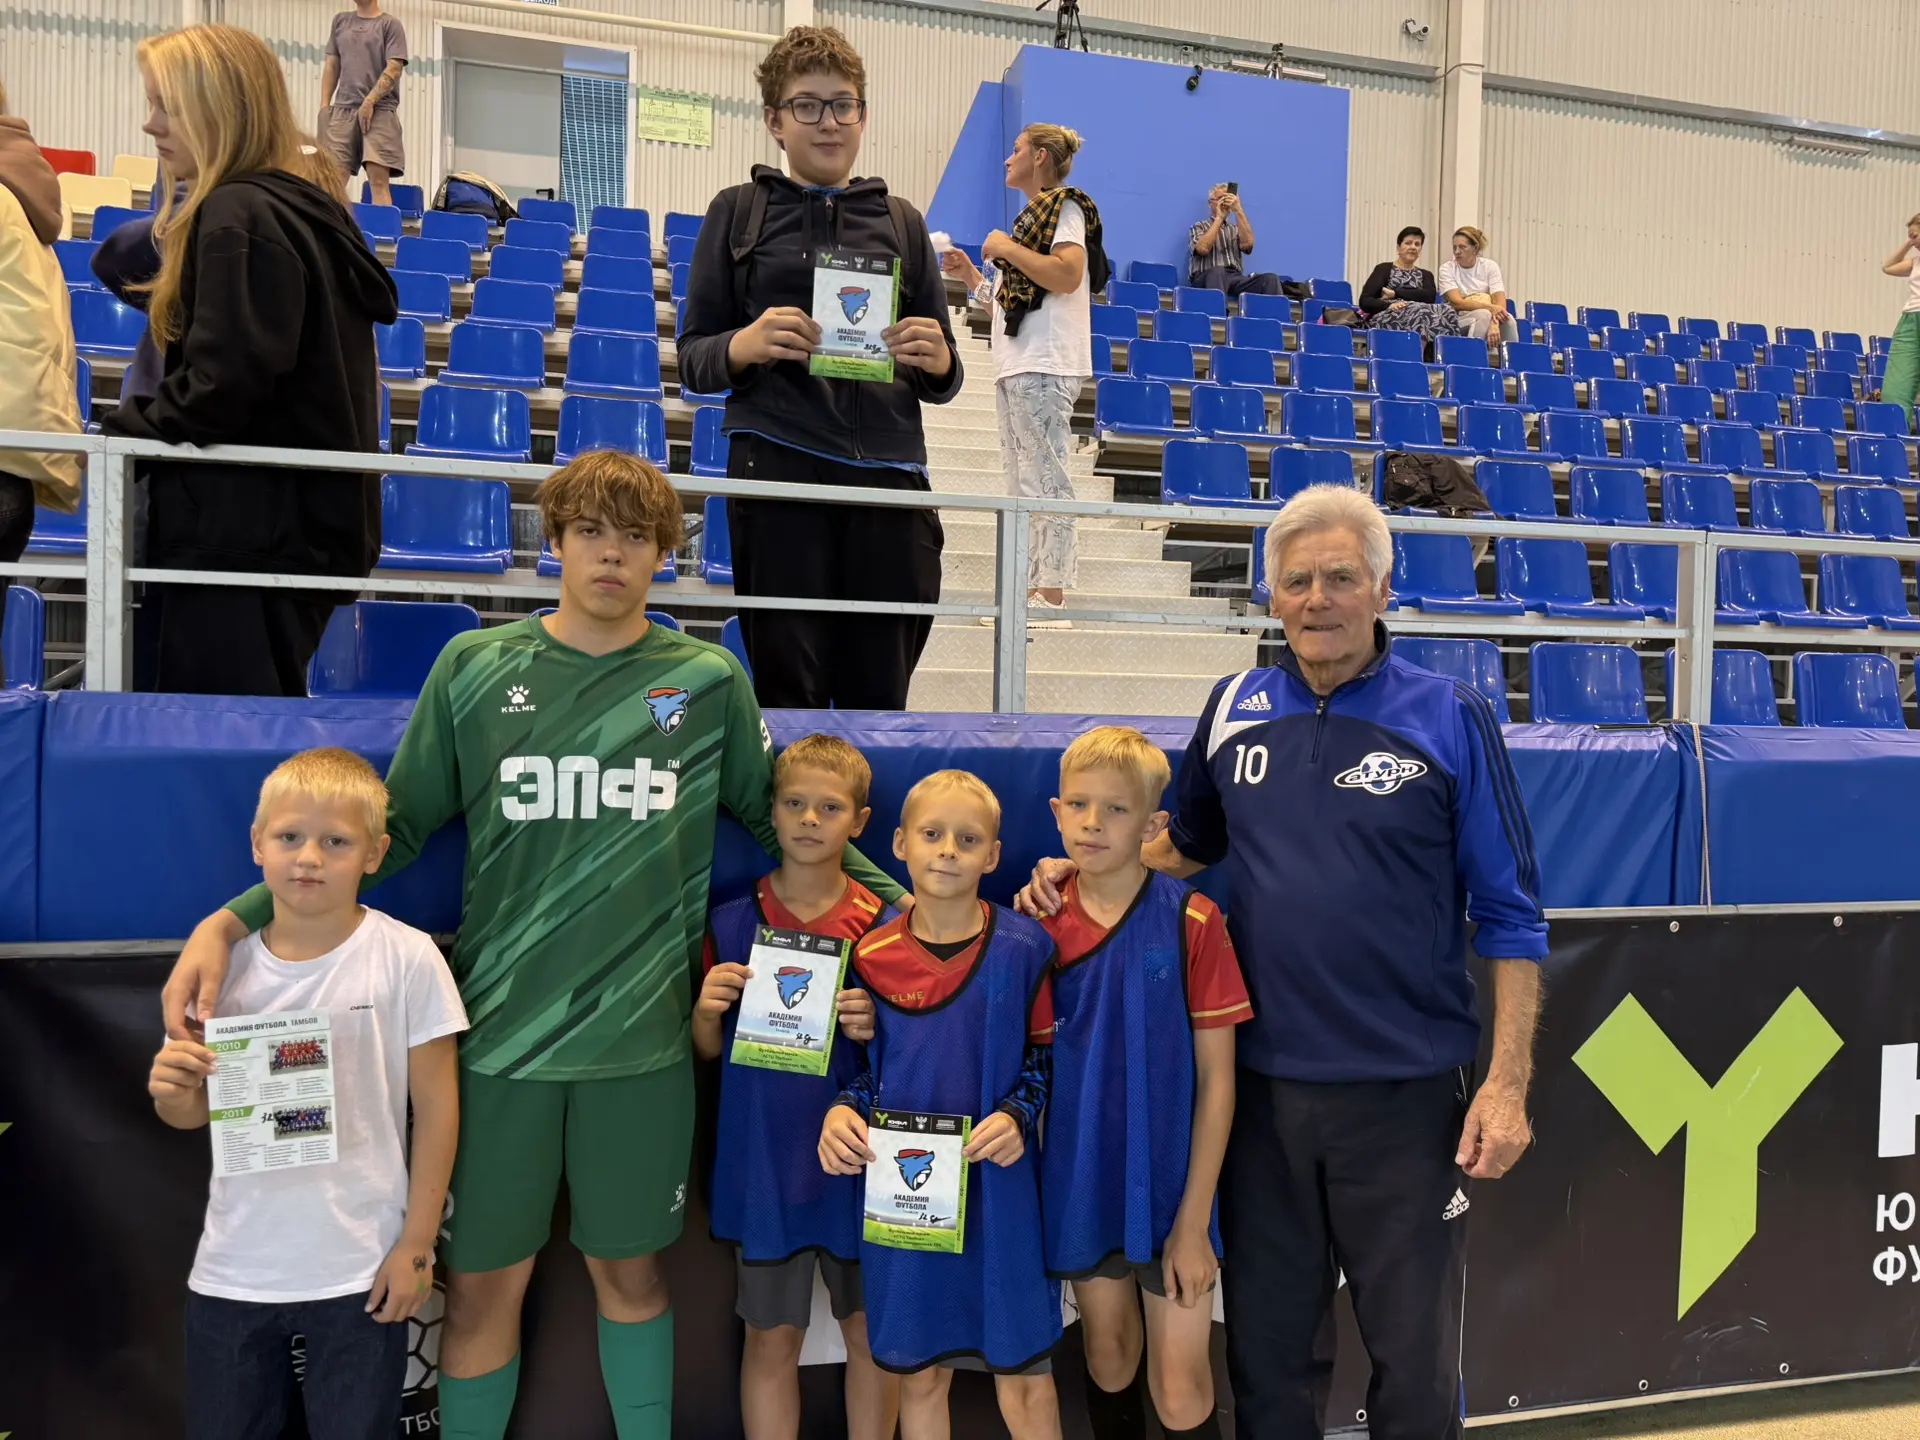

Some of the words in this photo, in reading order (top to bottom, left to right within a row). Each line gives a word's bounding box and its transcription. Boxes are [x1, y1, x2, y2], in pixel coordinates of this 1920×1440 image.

[501, 704, 536, 714] KELME
[1237, 702, 1272, 711] adidas
[1233, 745, 1268, 785] 10
[884, 991, 924, 1003] ELME
[768, 1012, 802, 1022] АКАДЕМИЯ
[216, 1023, 254, 1034] АКАДЕМИЯ
[254, 1020, 287, 1031] ФУТБОЛА
[291, 1017, 318, 1027] ТАМБОВ
[769, 1020, 799, 1030] ФУТБОЛА
[216, 1042, 241, 1052] 2010
[221, 1108, 244, 1119] 2011
[894, 1194, 930, 1203] АКАДЕМИЯ
[896, 1201, 927, 1210] ФУТБОЛА
[1442, 1199, 1470, 1221] adidas
